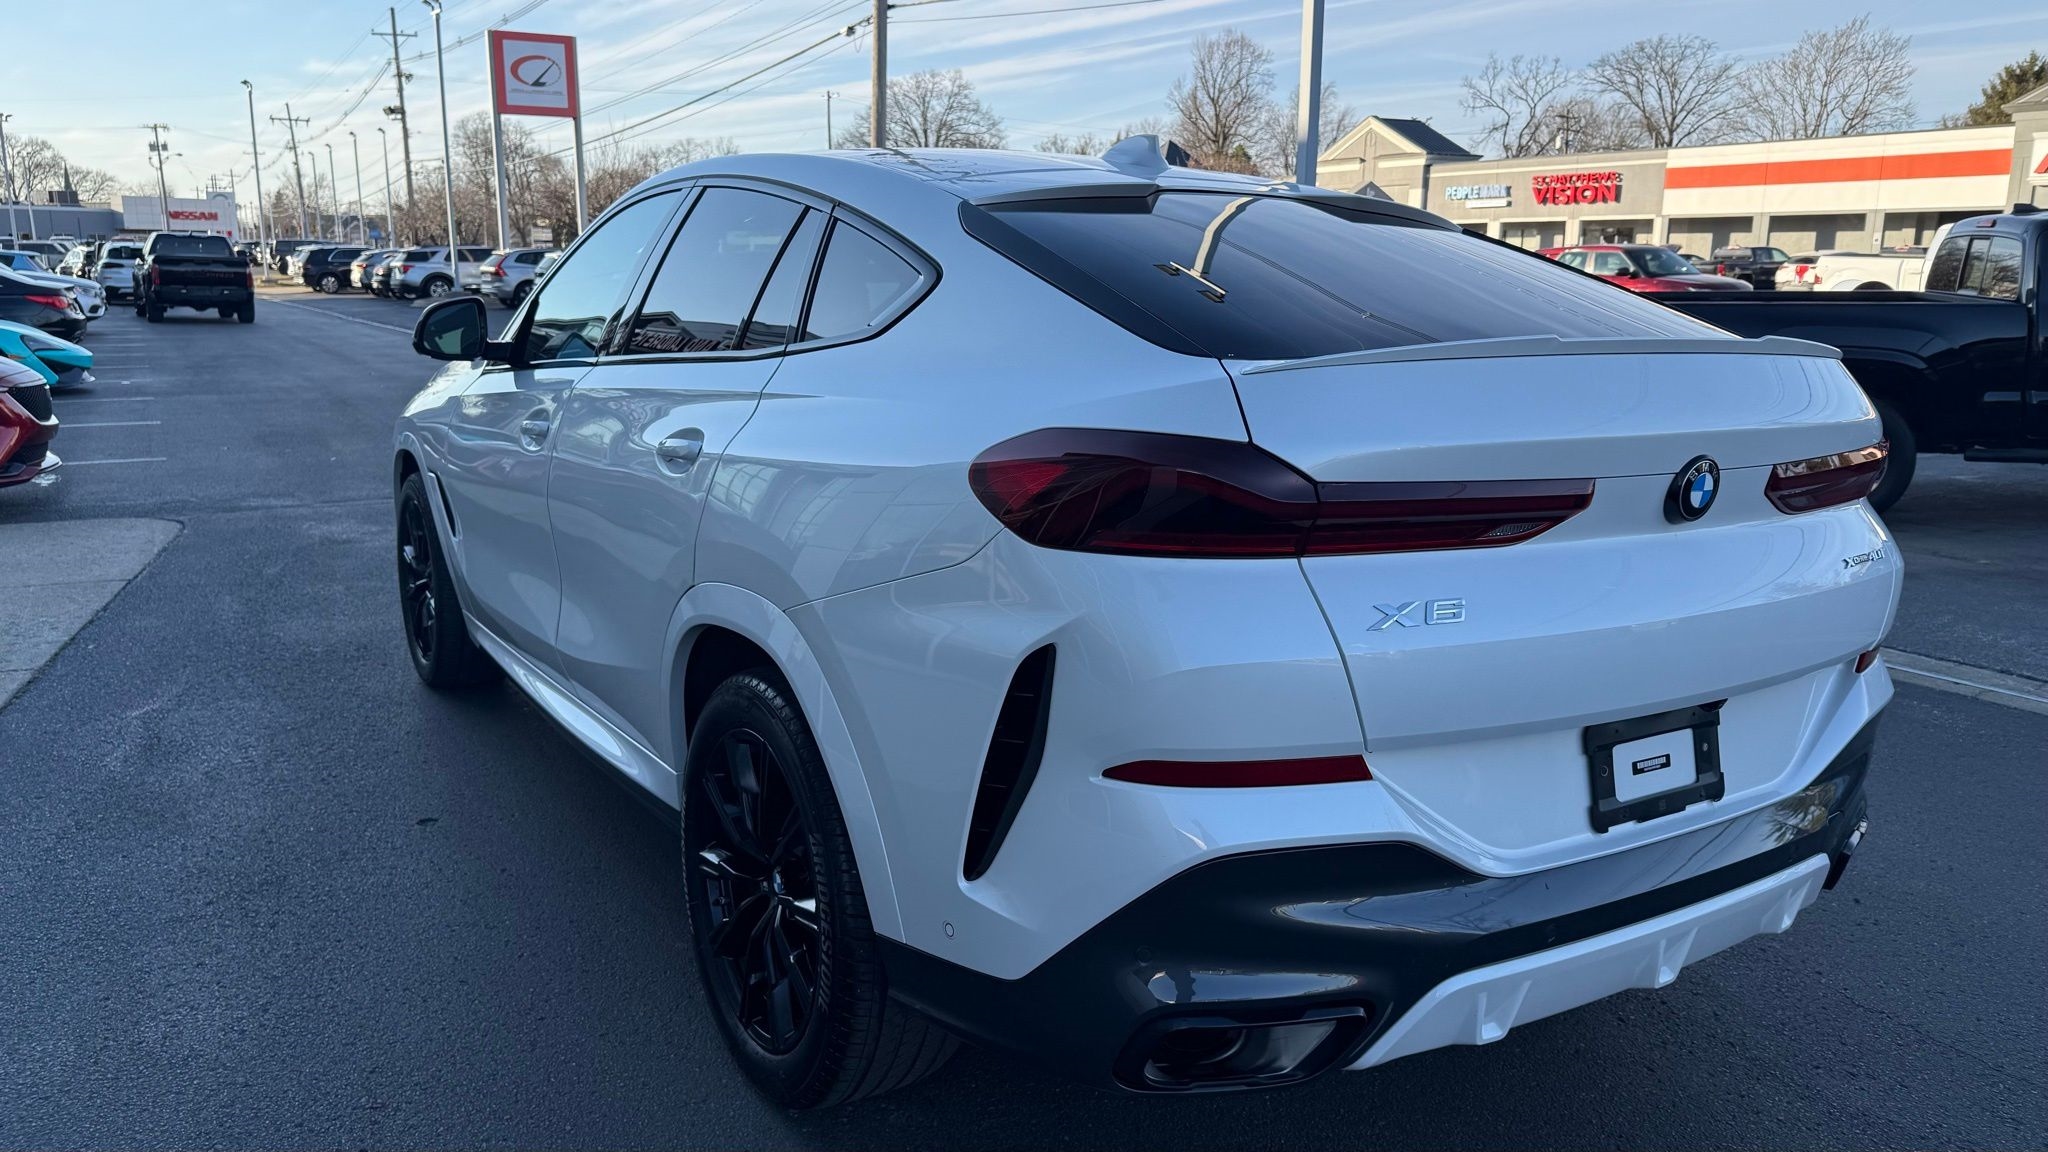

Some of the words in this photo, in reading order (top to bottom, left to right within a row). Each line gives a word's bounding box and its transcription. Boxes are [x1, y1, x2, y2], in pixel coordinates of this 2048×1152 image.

[1549, 171, 1618, 185] MATTHEWS
[1532, 185, 1617, 204] VISION
[1689, 462, 1719, 481] BMW
[1366, 598, 1466, 632] X6
